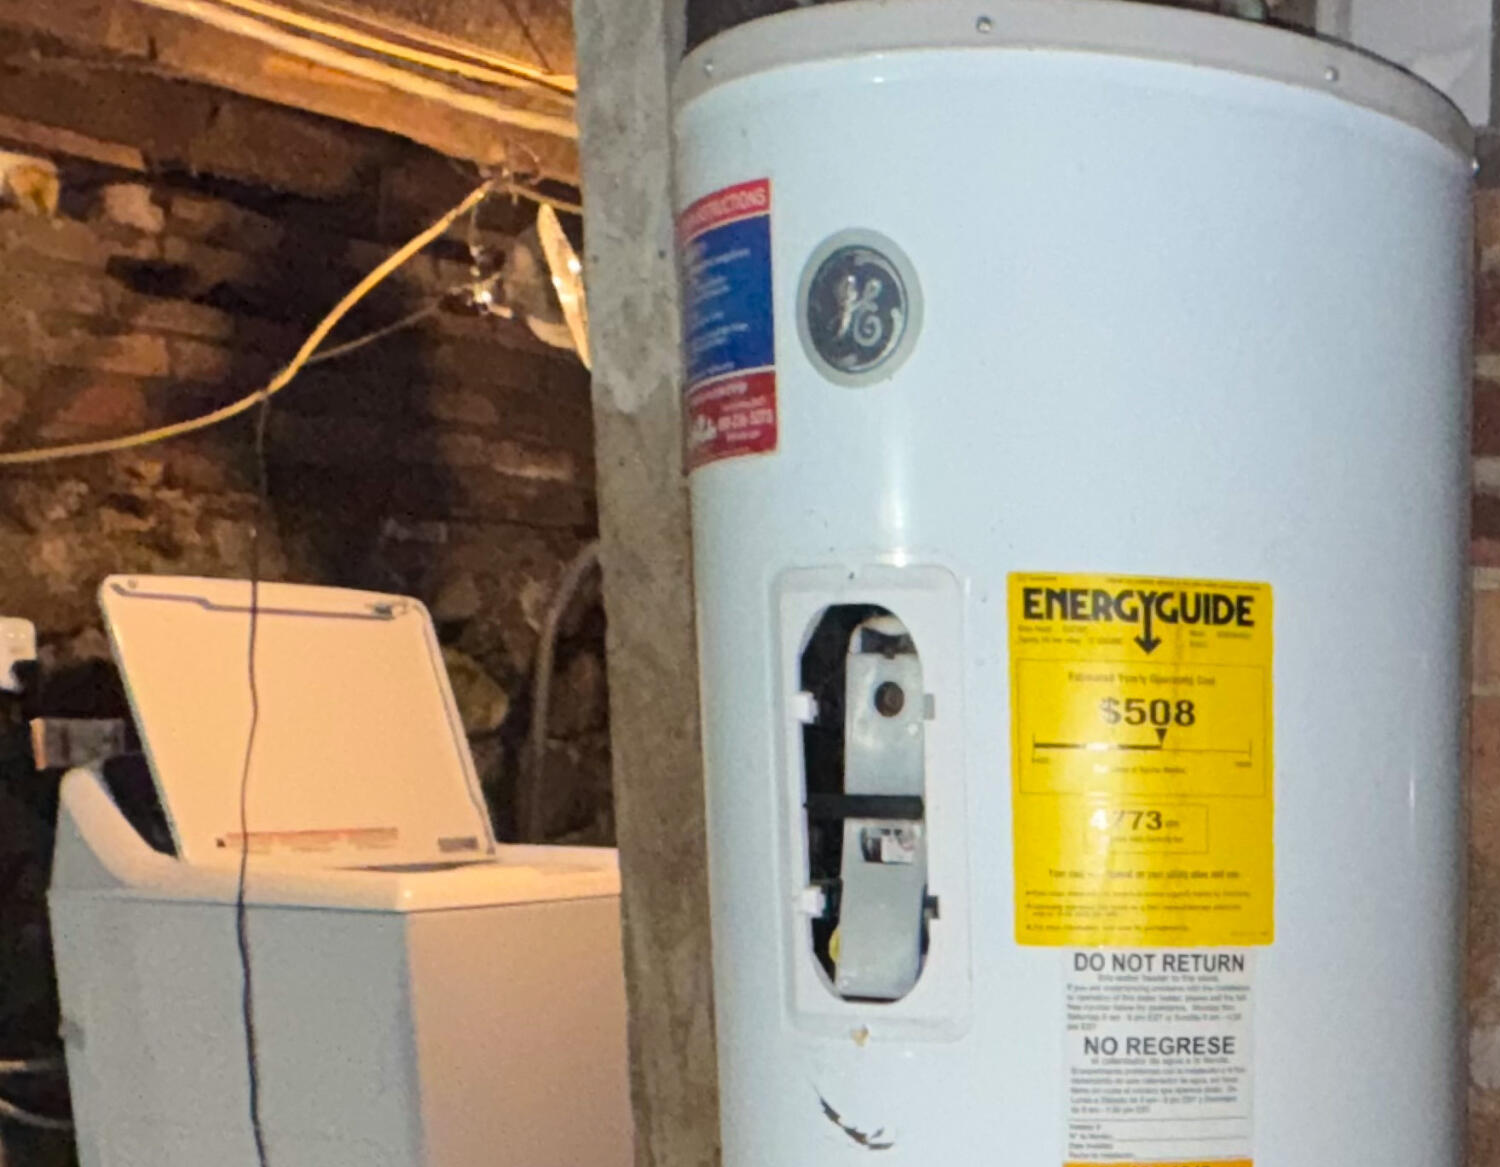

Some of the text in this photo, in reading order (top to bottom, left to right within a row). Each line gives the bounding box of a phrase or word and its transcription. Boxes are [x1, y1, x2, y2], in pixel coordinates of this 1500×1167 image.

[1023, 587, 1255, 629] ENERGYGUIDE
[1100, 697, 1197, 727] $508
[1074, 952, 1245, 972] DO NOT RETURN
[1083, 1036, 1236, 1055] NO REGRESE
